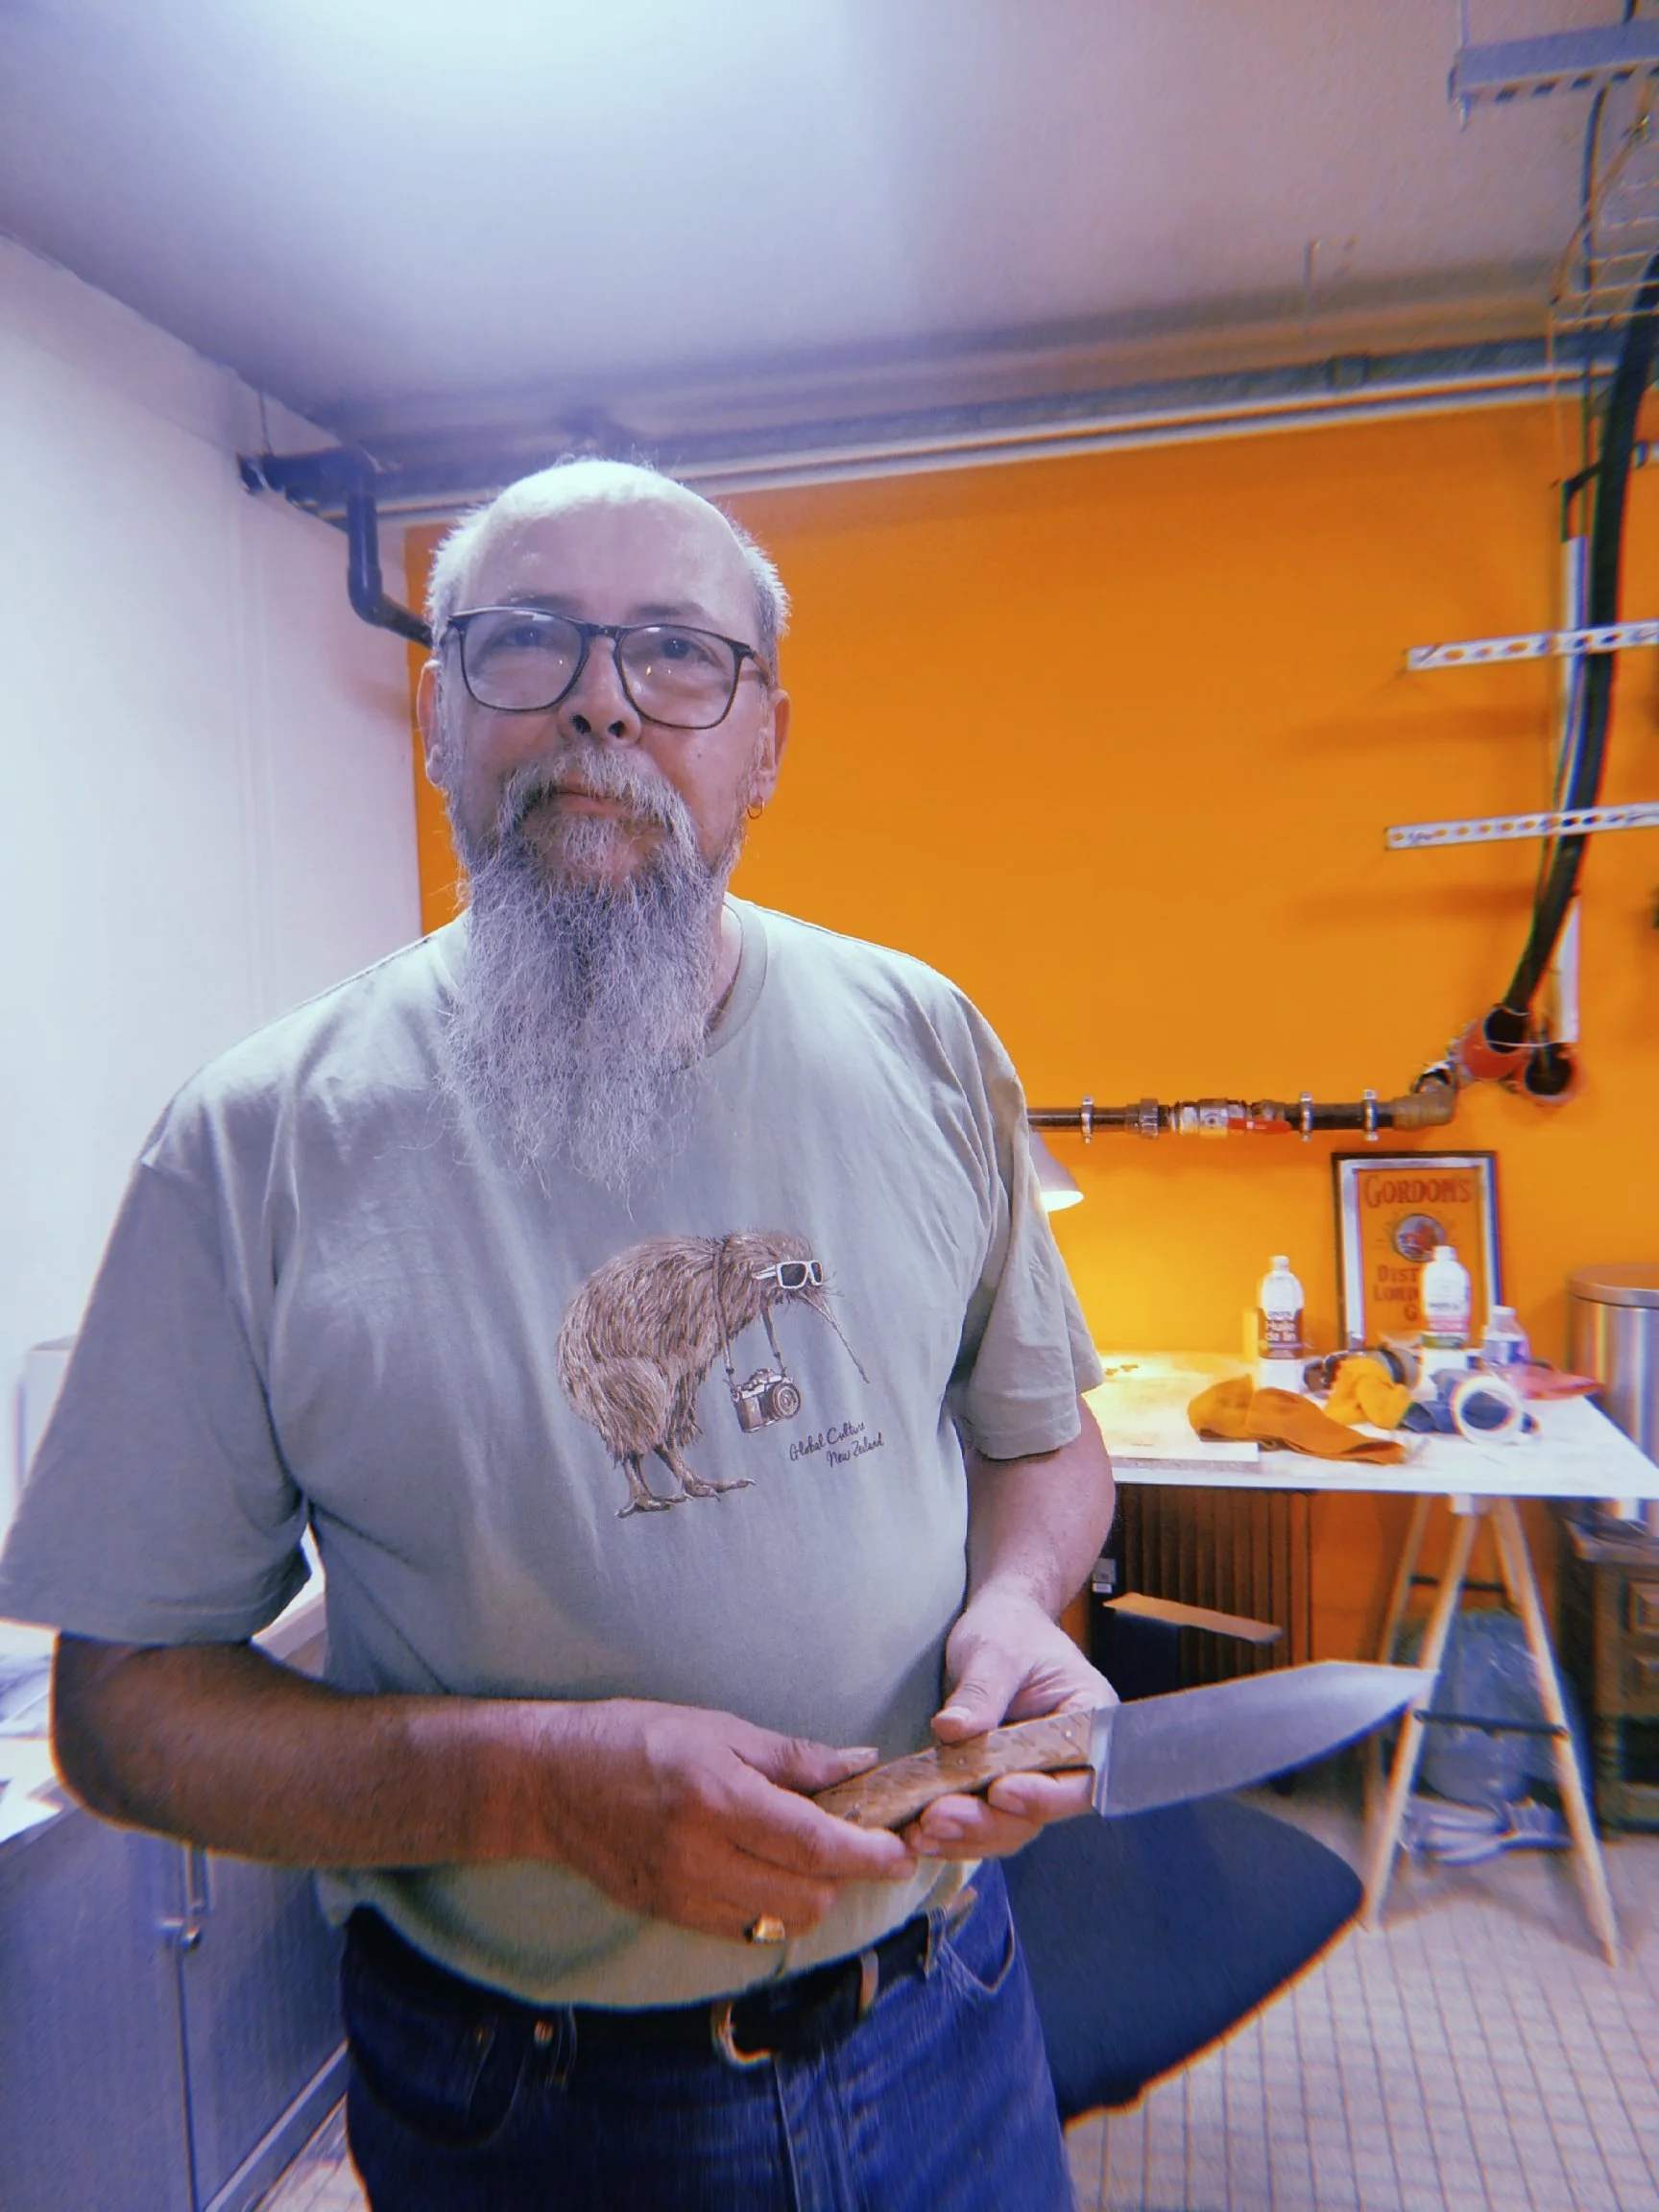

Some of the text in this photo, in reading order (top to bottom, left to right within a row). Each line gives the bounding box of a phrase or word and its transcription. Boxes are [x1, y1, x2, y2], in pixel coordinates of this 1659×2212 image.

[1377, 1263, 1419, 1283] DIST
[789, 1432, 826, 1461] Global
[827, 1450, 851, 1467] New
